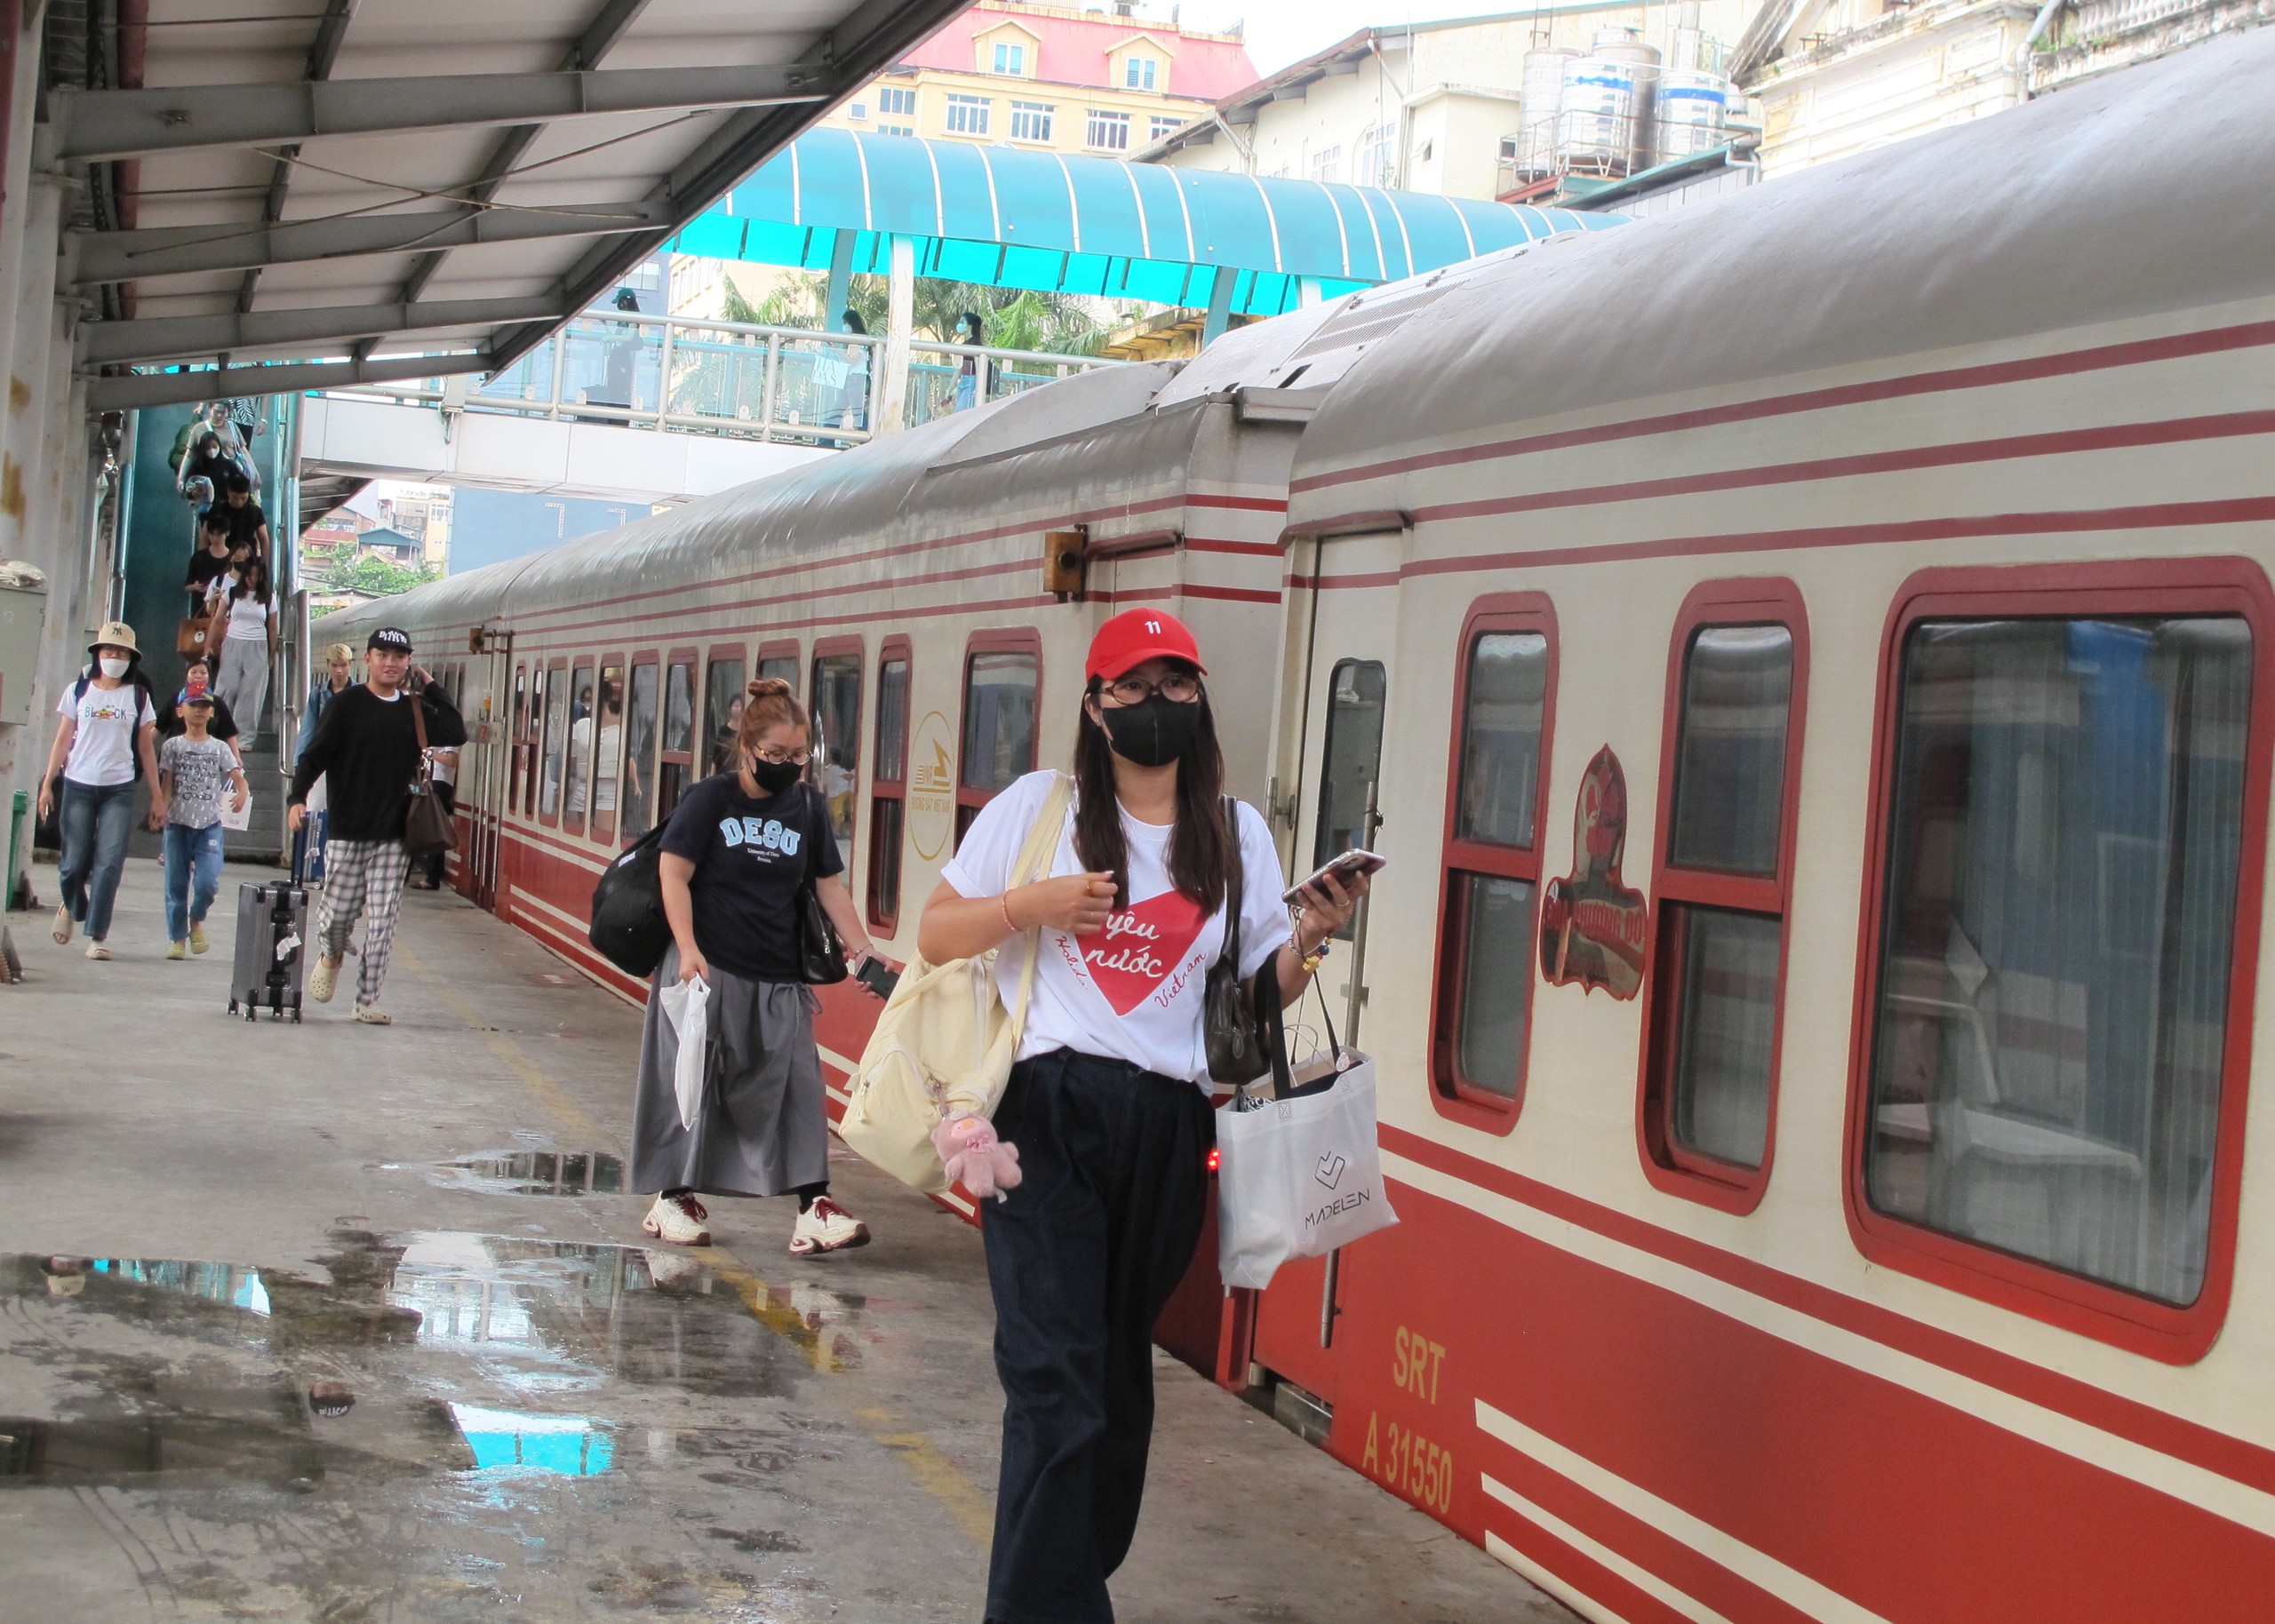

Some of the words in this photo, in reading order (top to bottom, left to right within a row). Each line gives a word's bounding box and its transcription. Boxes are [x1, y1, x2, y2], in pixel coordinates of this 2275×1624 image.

[1145, 621, 1161, 634] 11
[182, 792, 212, 800] GOOD
[1106, 911, 1160, 940] yêu
[1085, 945, 1162, 977] nước
[1154, 953, 1207, 1007] Vietnam
[1305, 1188, 1369, 1230] MADELEN
[1393, 1325, 1446, 1405] SRT
[1362, 1410, 1377, 1475] A
[1385, 1421, 1452, 1515] 31550
